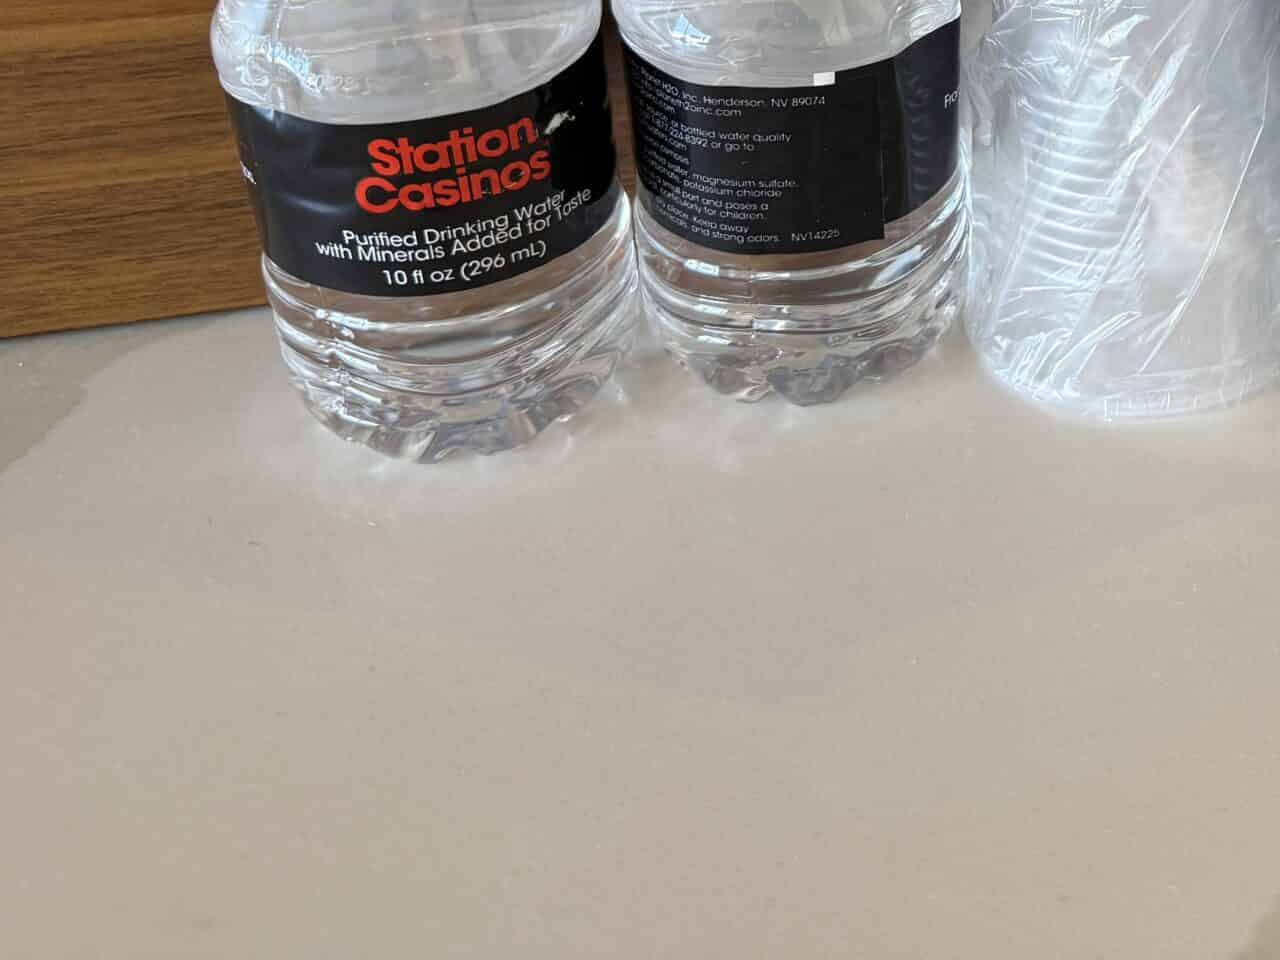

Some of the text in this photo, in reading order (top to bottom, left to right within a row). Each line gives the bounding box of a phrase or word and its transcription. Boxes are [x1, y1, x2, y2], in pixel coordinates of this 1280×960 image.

[771, 98, 788, 108] NV
[367, 116, 537, 177] Station
[719, 132, 750, 142] water
[753, 133, 792, 143] quality
[710, 141, 722, 150] or
[725, 143, 740, 153] go
[743, 143, 755, 152] to
[354, 149, 551, 214] Casinos
[683, 178, 734, 197] potassium
[736, 188, 783, 198] chloride
[693, 172, 756, 189] magnesium
[702, 197, 723, 208] and
[725, 201, 757, 212] poses
[760, 203, 769, 211] a
[704, 205, 718, 217] for
[315, 188, 592, 264] with Minerals Added for Taste
[342, 190, 566, 248] Purified Drinking Water
[720, 222, 750, 234] away
[691, 223, 711, 237] and
[712, 230, 746, 244] strong
[382, 240, 548, 286] 10 fl oz (296 mL)
